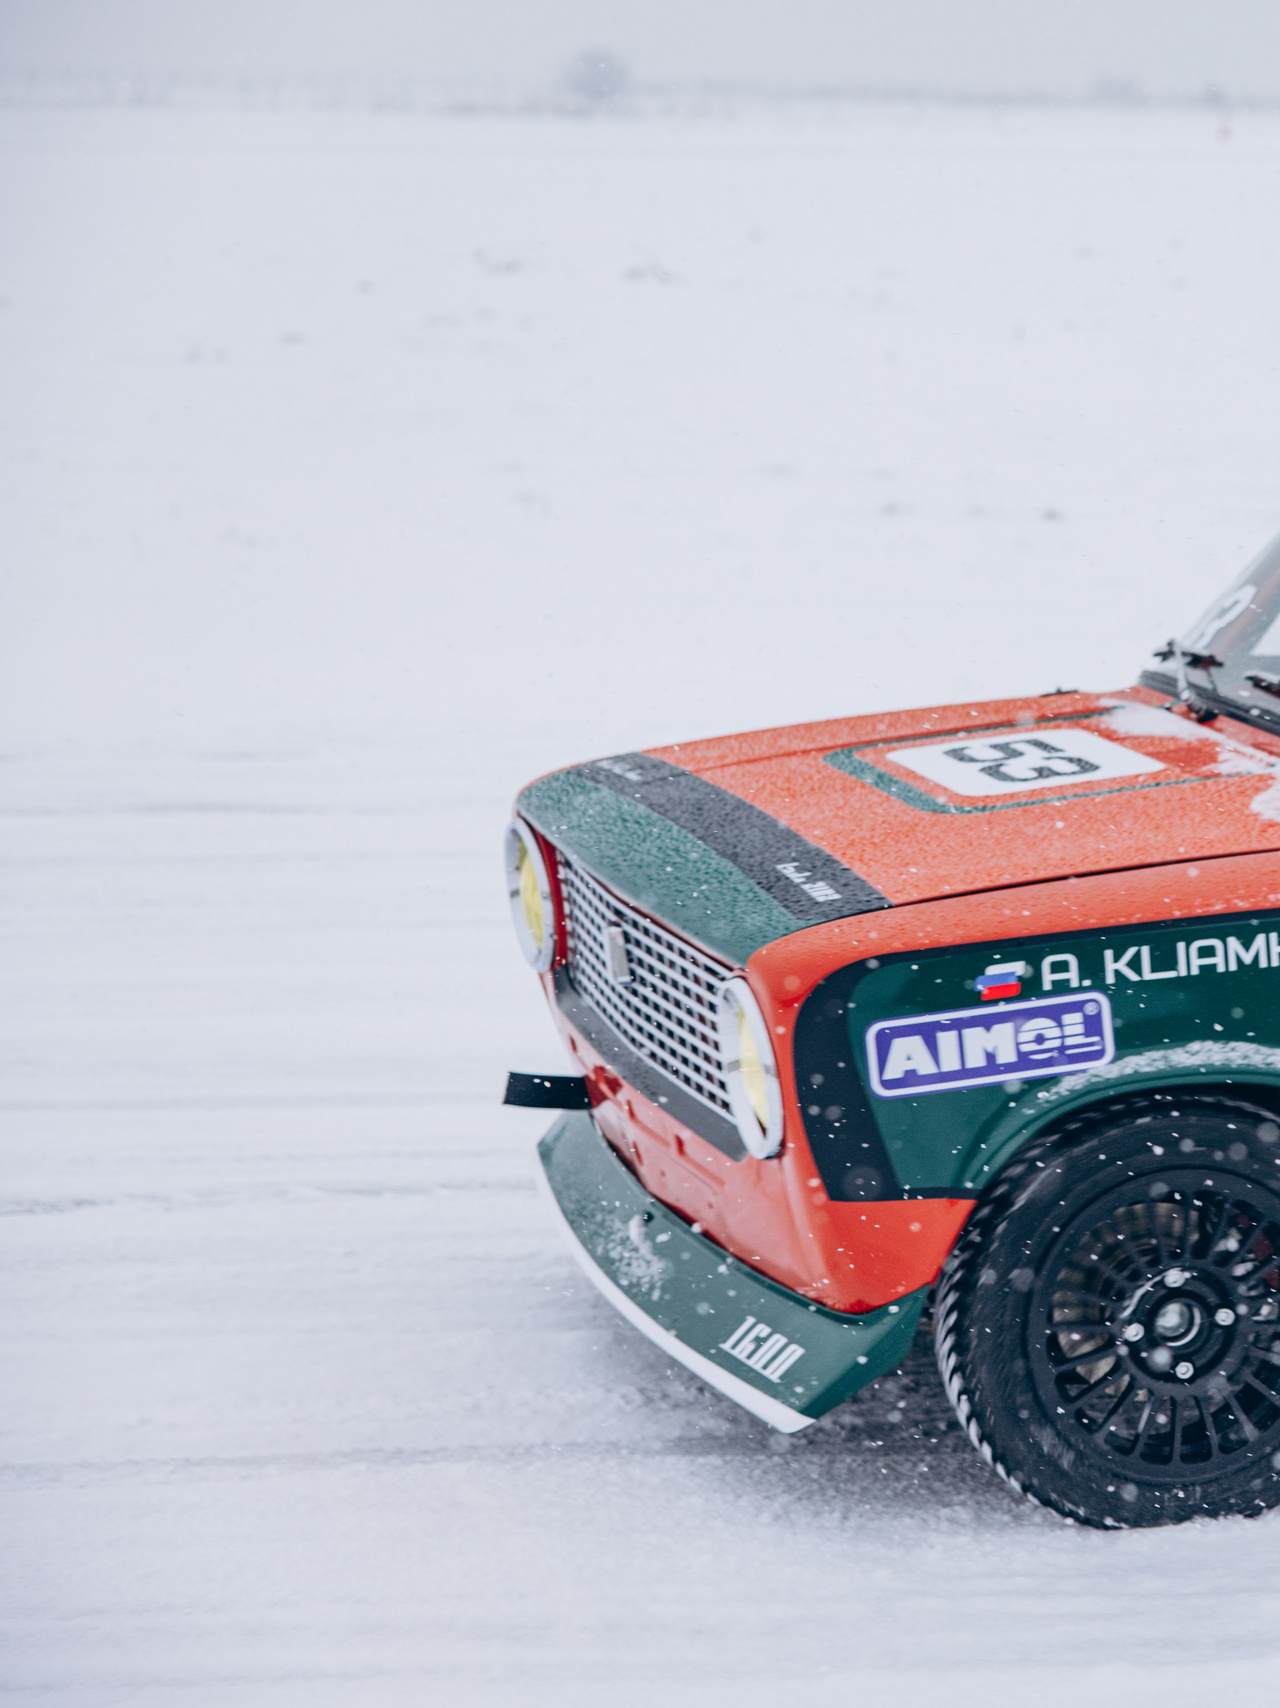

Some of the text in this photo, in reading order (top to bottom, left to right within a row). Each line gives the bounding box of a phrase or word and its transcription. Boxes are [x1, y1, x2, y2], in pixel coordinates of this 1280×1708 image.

[943, 738, 1101, 782] 53
[1041, 953, 1092, 991] A.
[881, 1011, 1102, 1080] AIMOL
[718, 1315, 806, 1383] 1600
